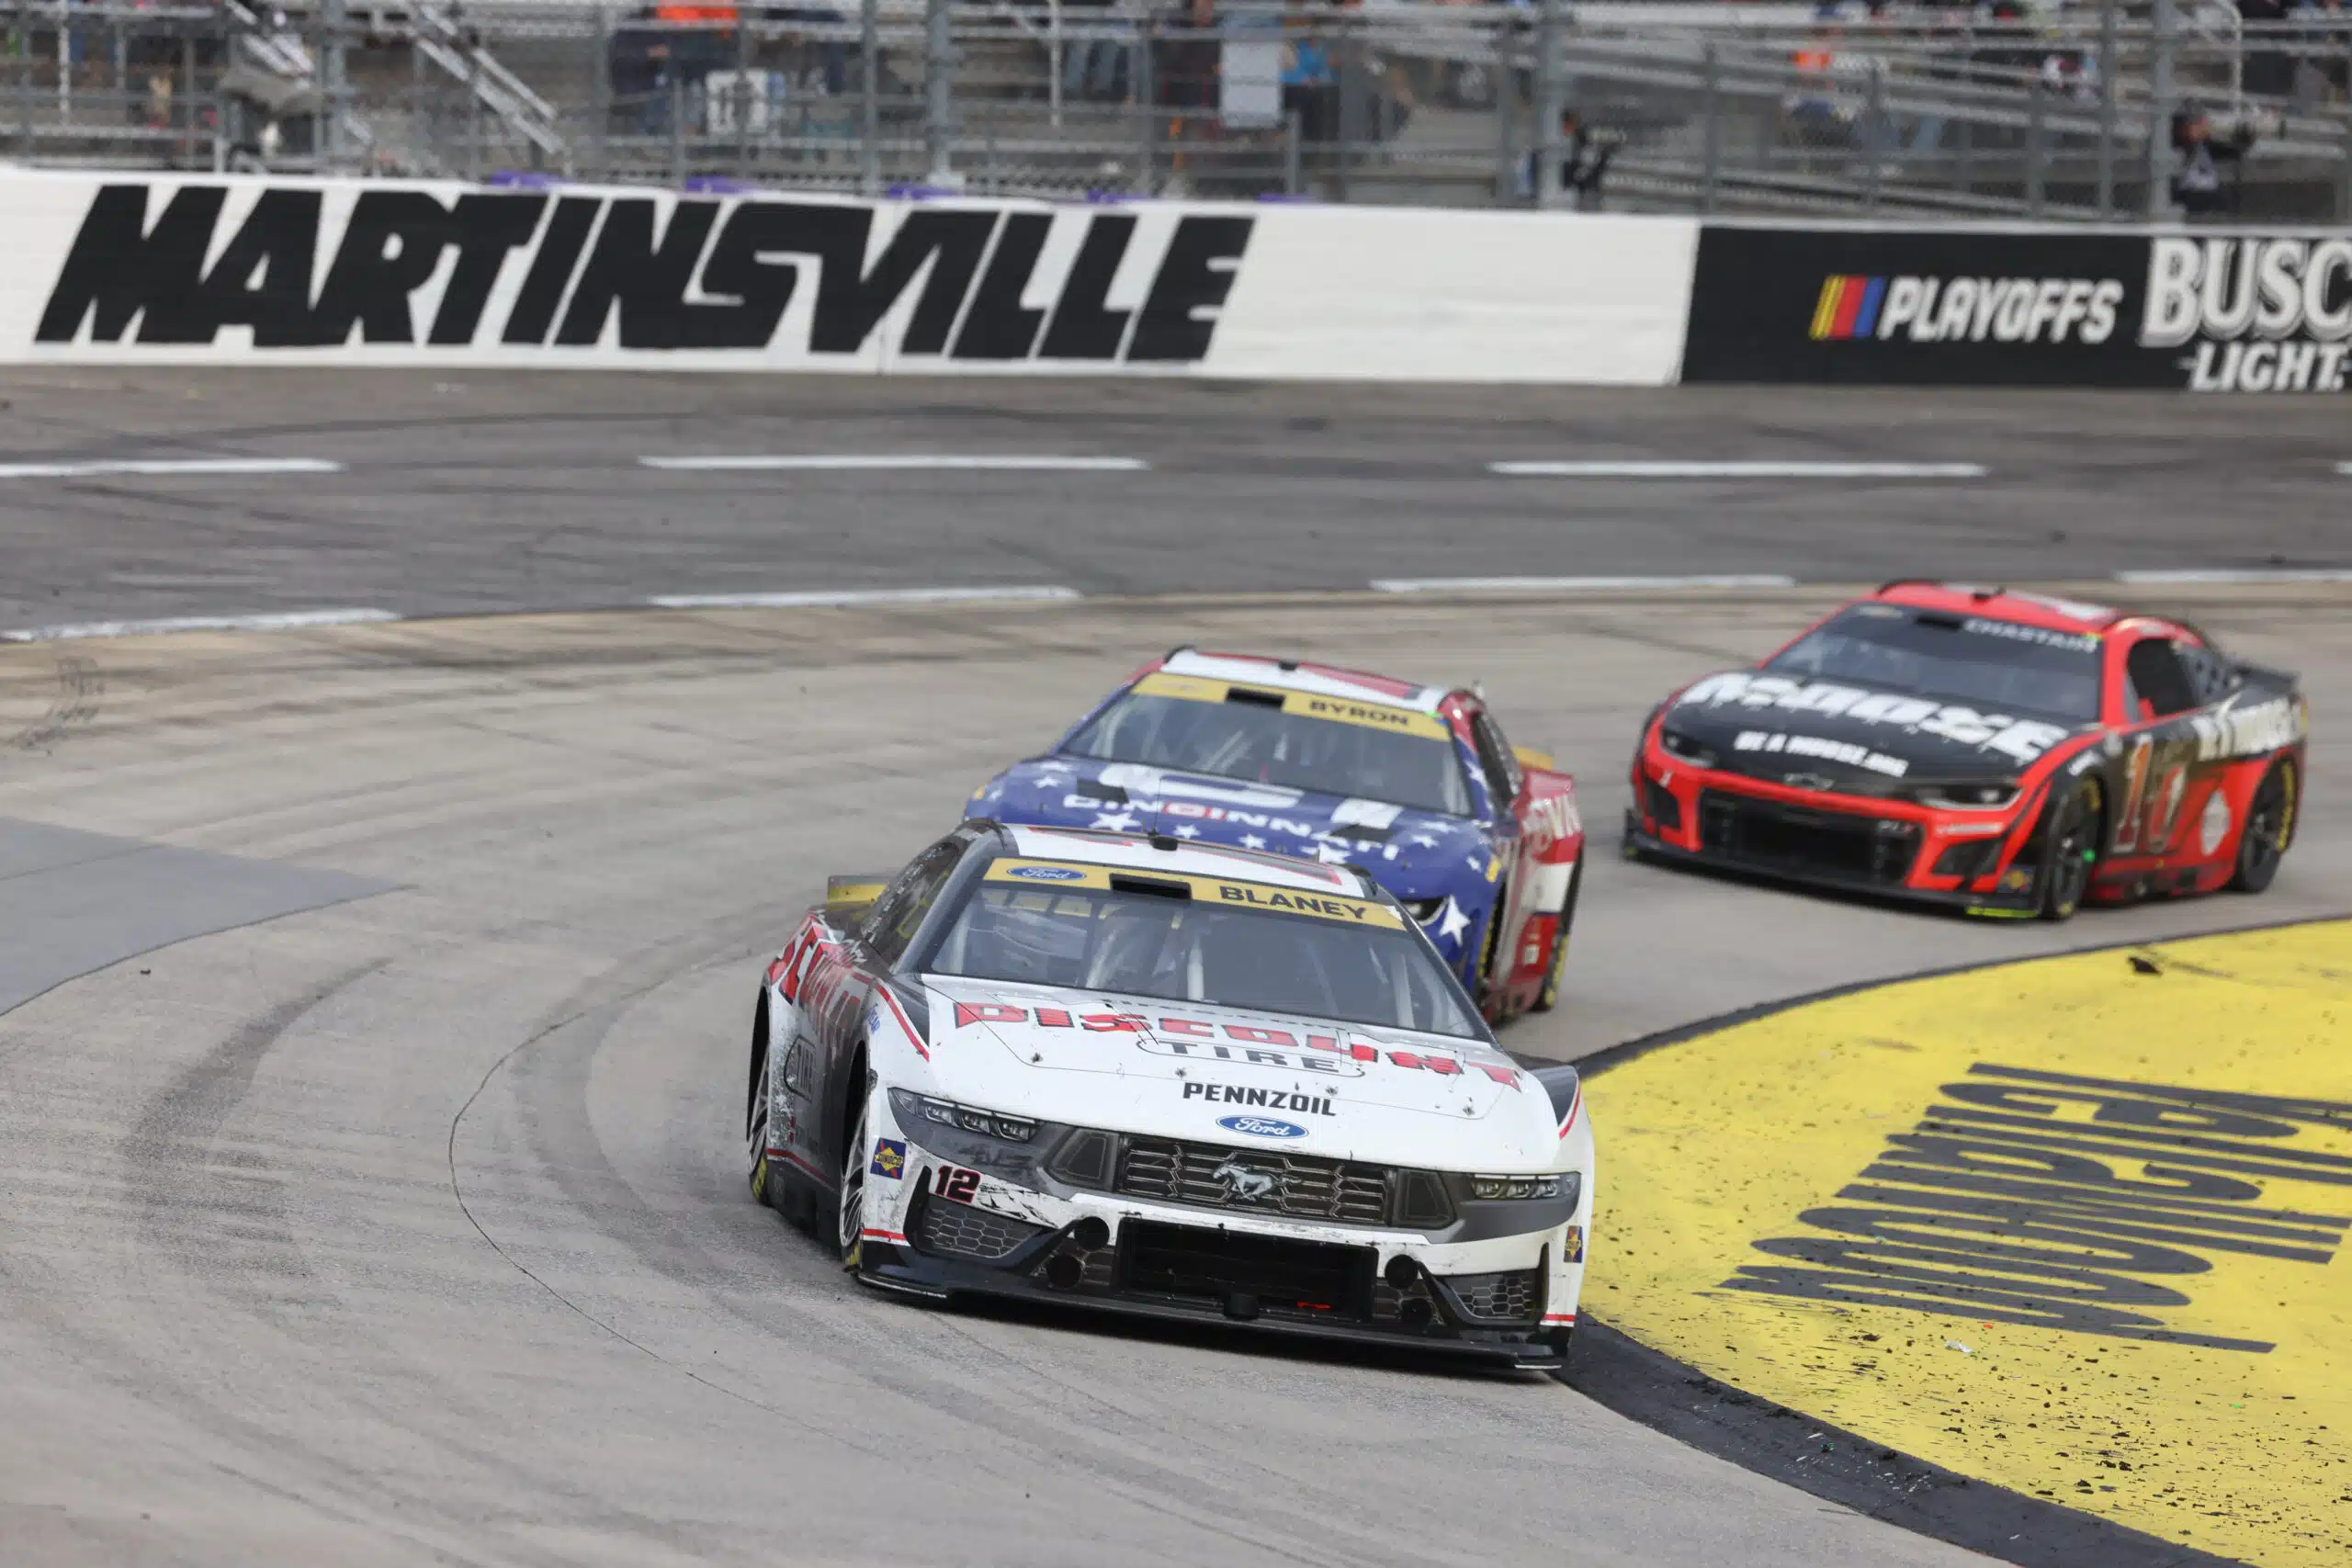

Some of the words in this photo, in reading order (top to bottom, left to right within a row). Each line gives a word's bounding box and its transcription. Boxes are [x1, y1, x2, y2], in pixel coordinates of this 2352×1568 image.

[34, 184, 1257, 362] MARTINSVILLE
[1876, 274, 2124, 345] PLAYOFFS
[1308, 699, 1409, 727] BYRON
[1021, 865, 1072, 880] Ford
[1218, 885, 1367, 919] BLANEY
[954, 1000, 1521, 1094] DISCOUNT
[1159, 1040, 1340, 1074] TIRE
[1182, 1081, 1338, 1117] PENNZOIL
[1232, 1116, 1293, 1138] Ford
[874, 1152, 904, 1168] SUNOCO
[933, 1164, 982, 1205] 12
